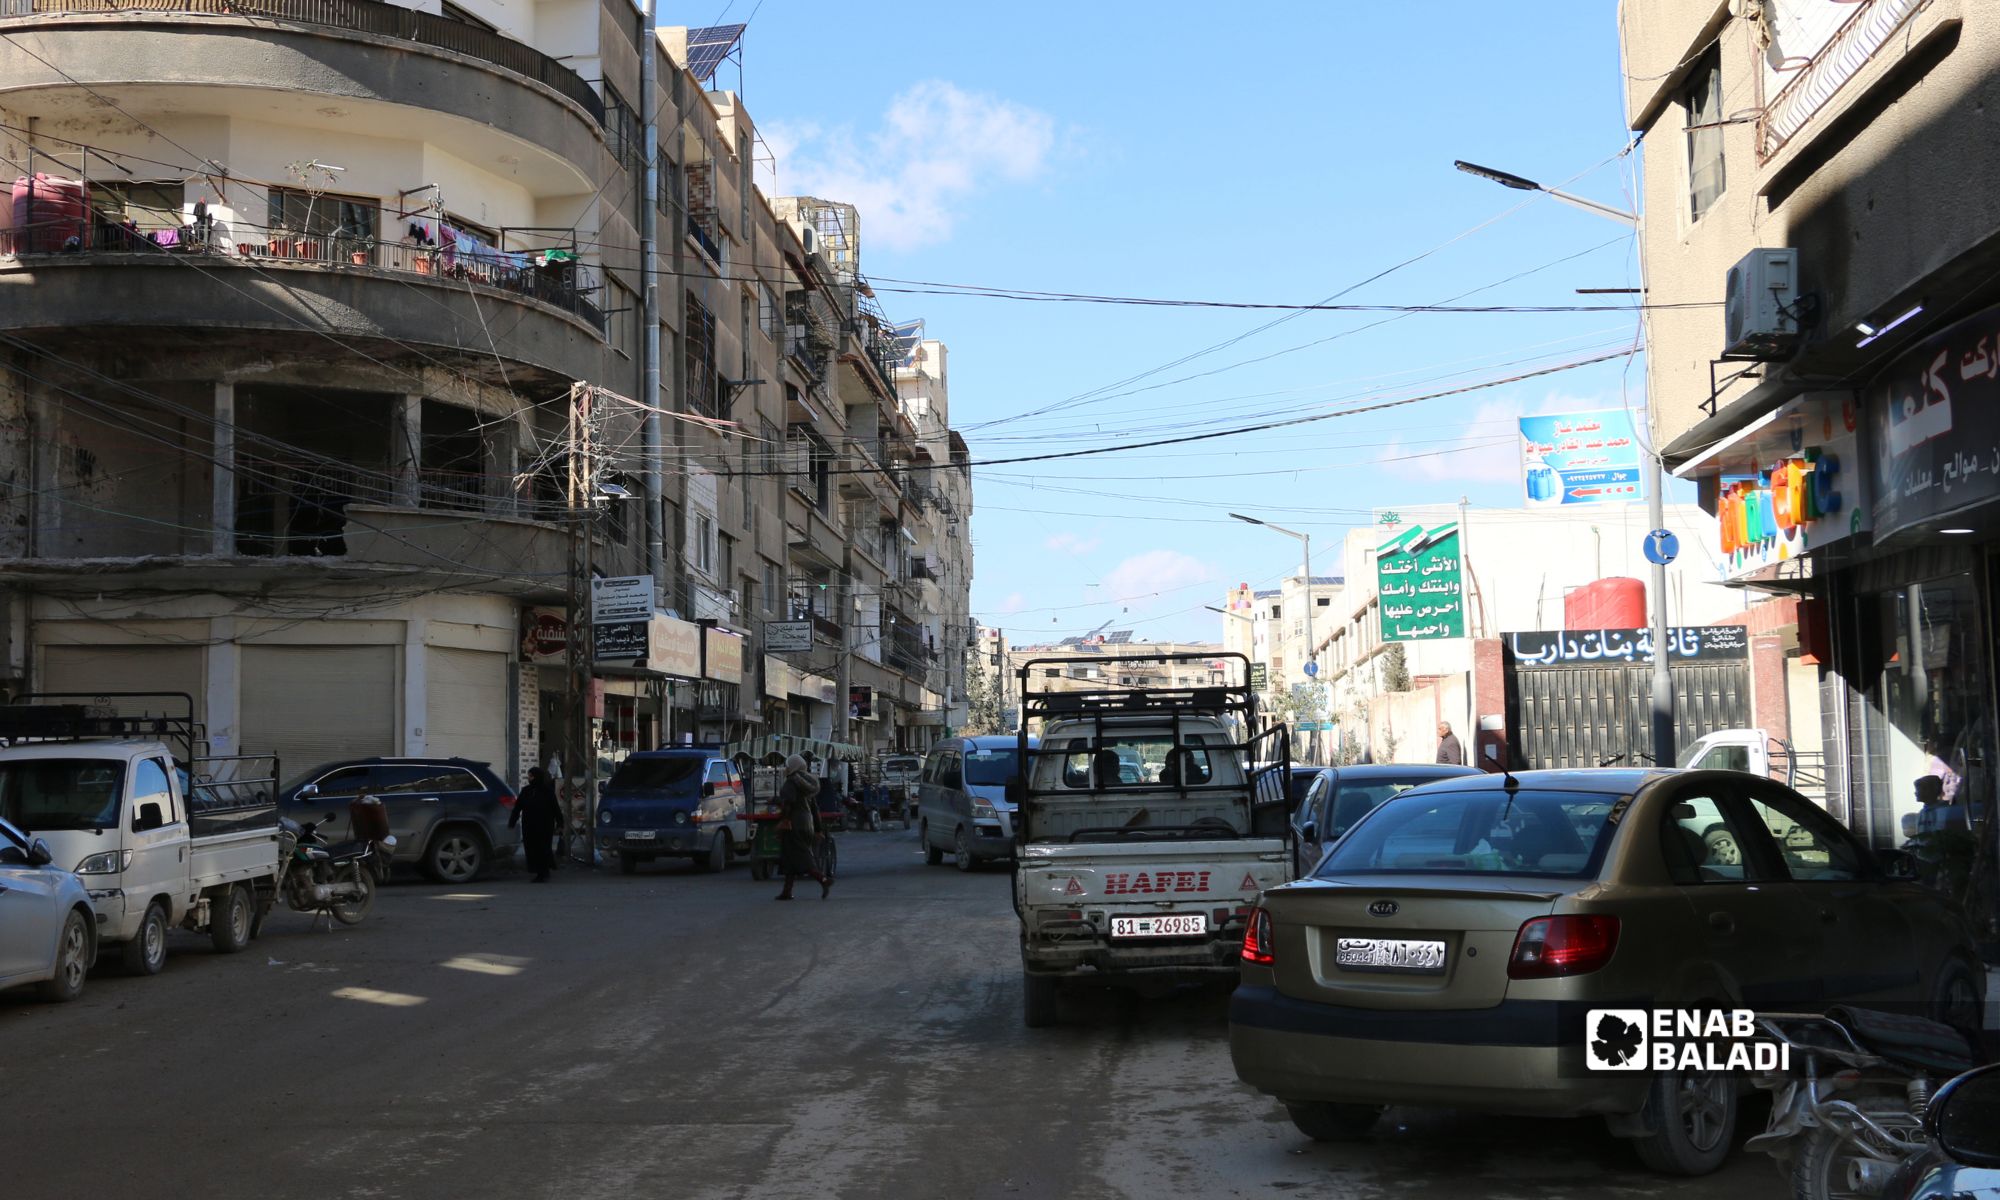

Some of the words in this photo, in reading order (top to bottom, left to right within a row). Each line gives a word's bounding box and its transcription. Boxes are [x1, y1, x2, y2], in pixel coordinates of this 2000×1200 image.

[1586, 440, 1602, 449] عبد
[1607, 438, 1629, 447] محمد
[1381, 559, 1418, 575] أختك
[1421, 556, 1457, 575] الأنثى
[1380, 581, 1415, 597] وأمك
[1418, 579, 1460, 595] وابنتك
[1384, 603, 1413, 619] عليها
[1416, 600, 1459, 618] احرص
[1396, 622, 1450, 638] واحمها
[1512, 629, 1579, 666] داريا
[1579, 629, 1634, 662] بنات
[1636, 627, 1699, 662] ثانية
[1103, 871, 1212, 895] HAFEI
[1372, 903, 1394, 912] KIA
[1116, 918, 1135, 935] 81
[1154, 917, 1201, 934] 26985
